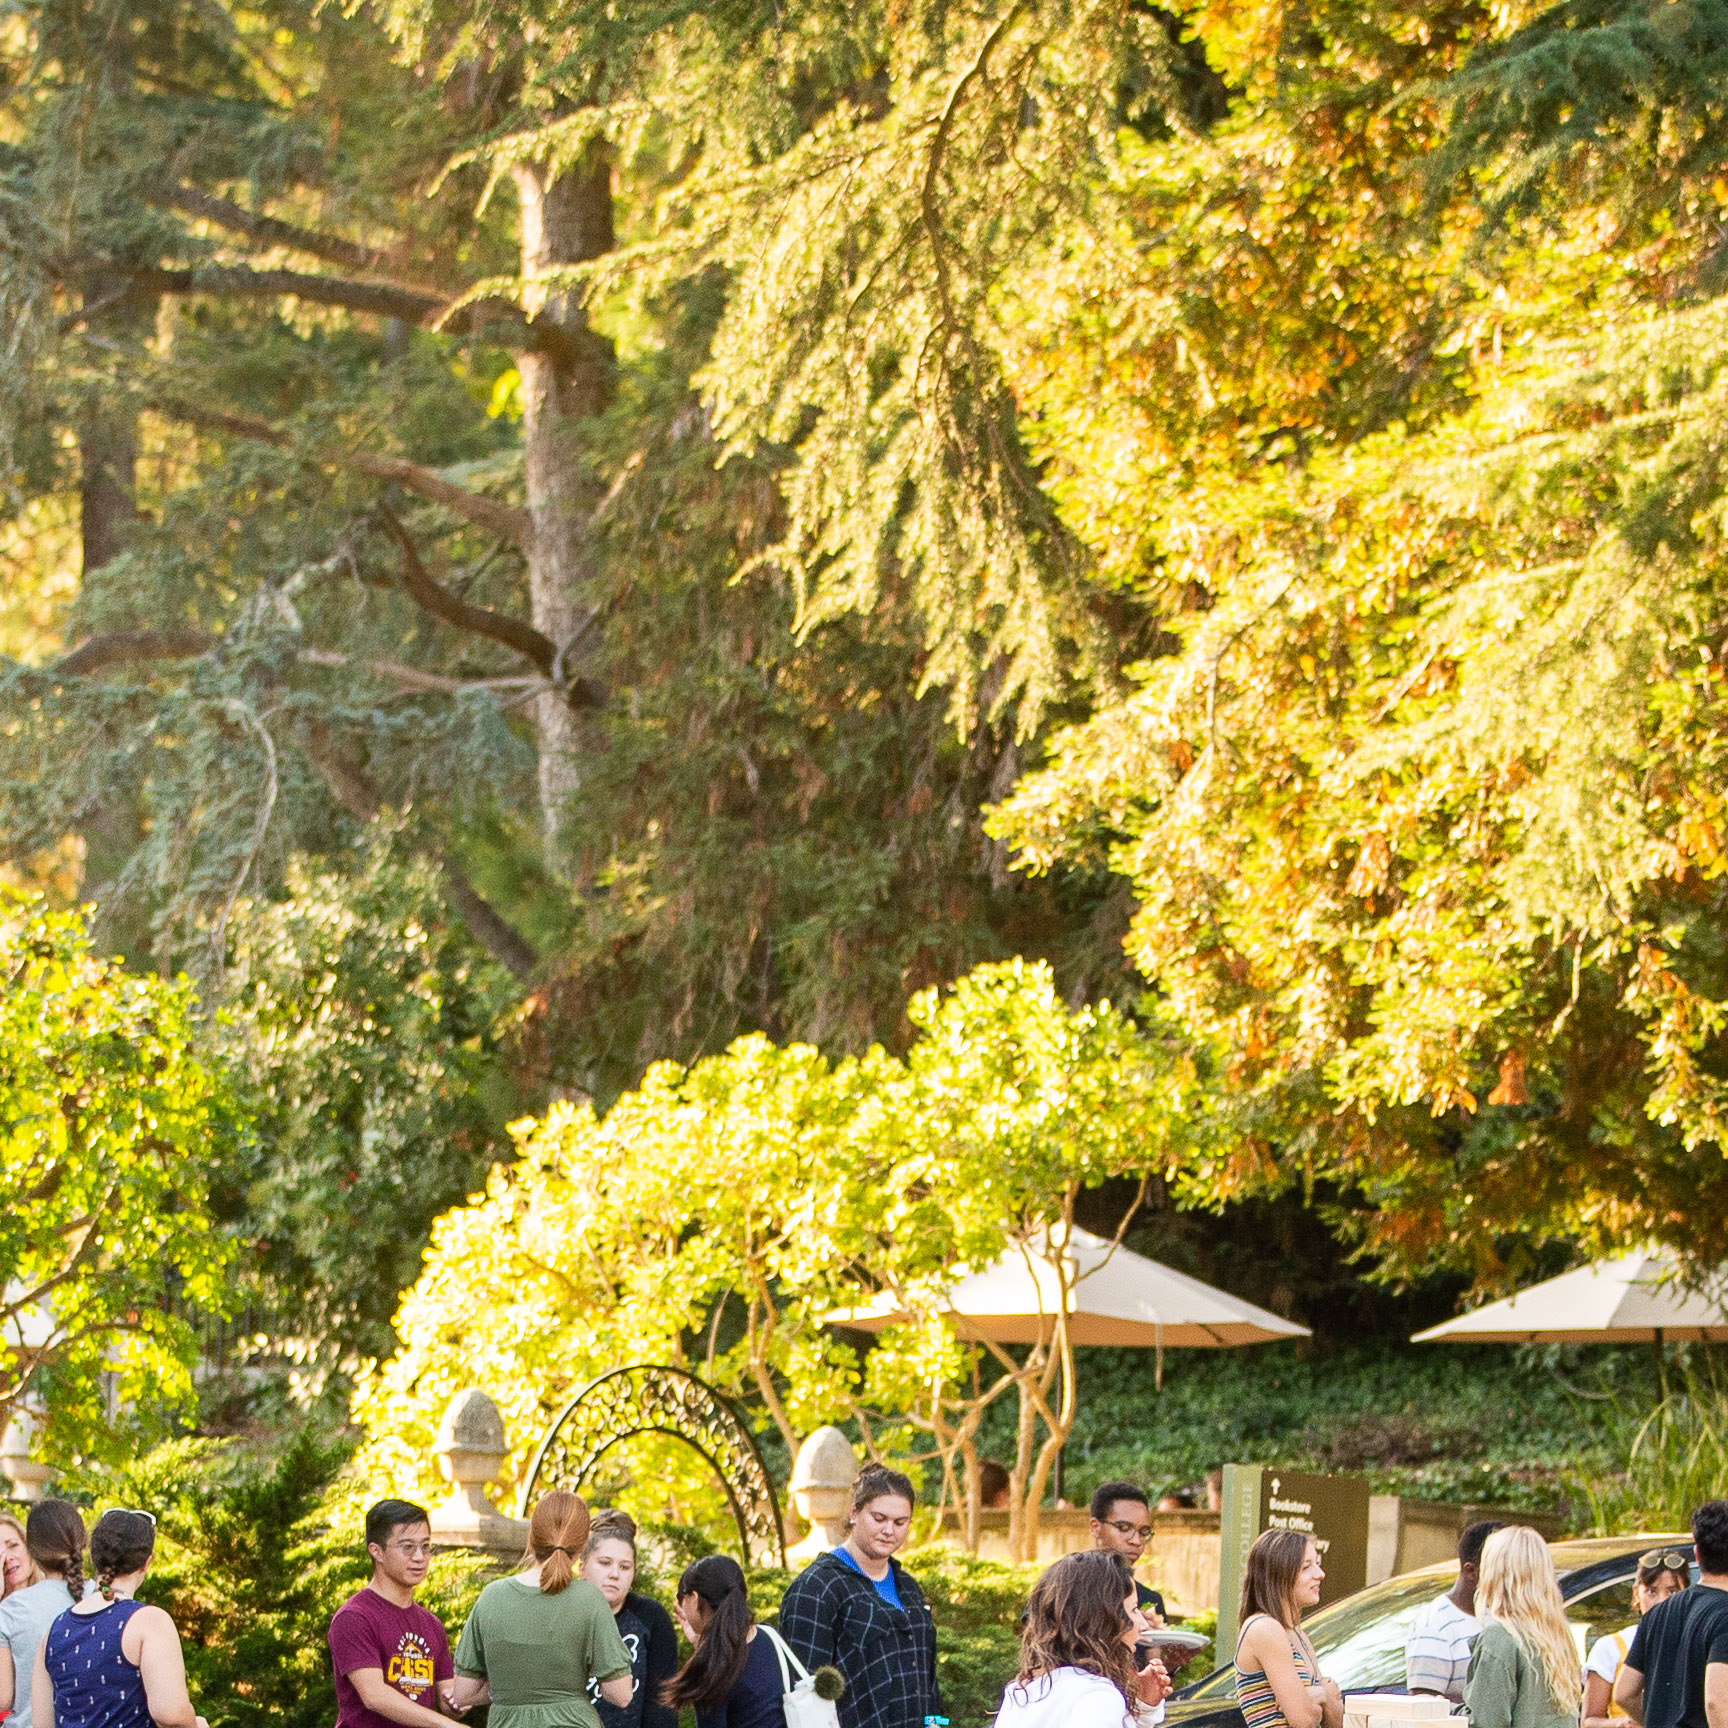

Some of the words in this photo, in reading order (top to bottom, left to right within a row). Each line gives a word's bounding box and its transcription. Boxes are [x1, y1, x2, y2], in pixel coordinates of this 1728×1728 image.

[1270, 1497, 1311, 1514] Bookstore
[1269, 1514, 1287, 1529] Post
[1289, 1517, 1313, 1532] Office
